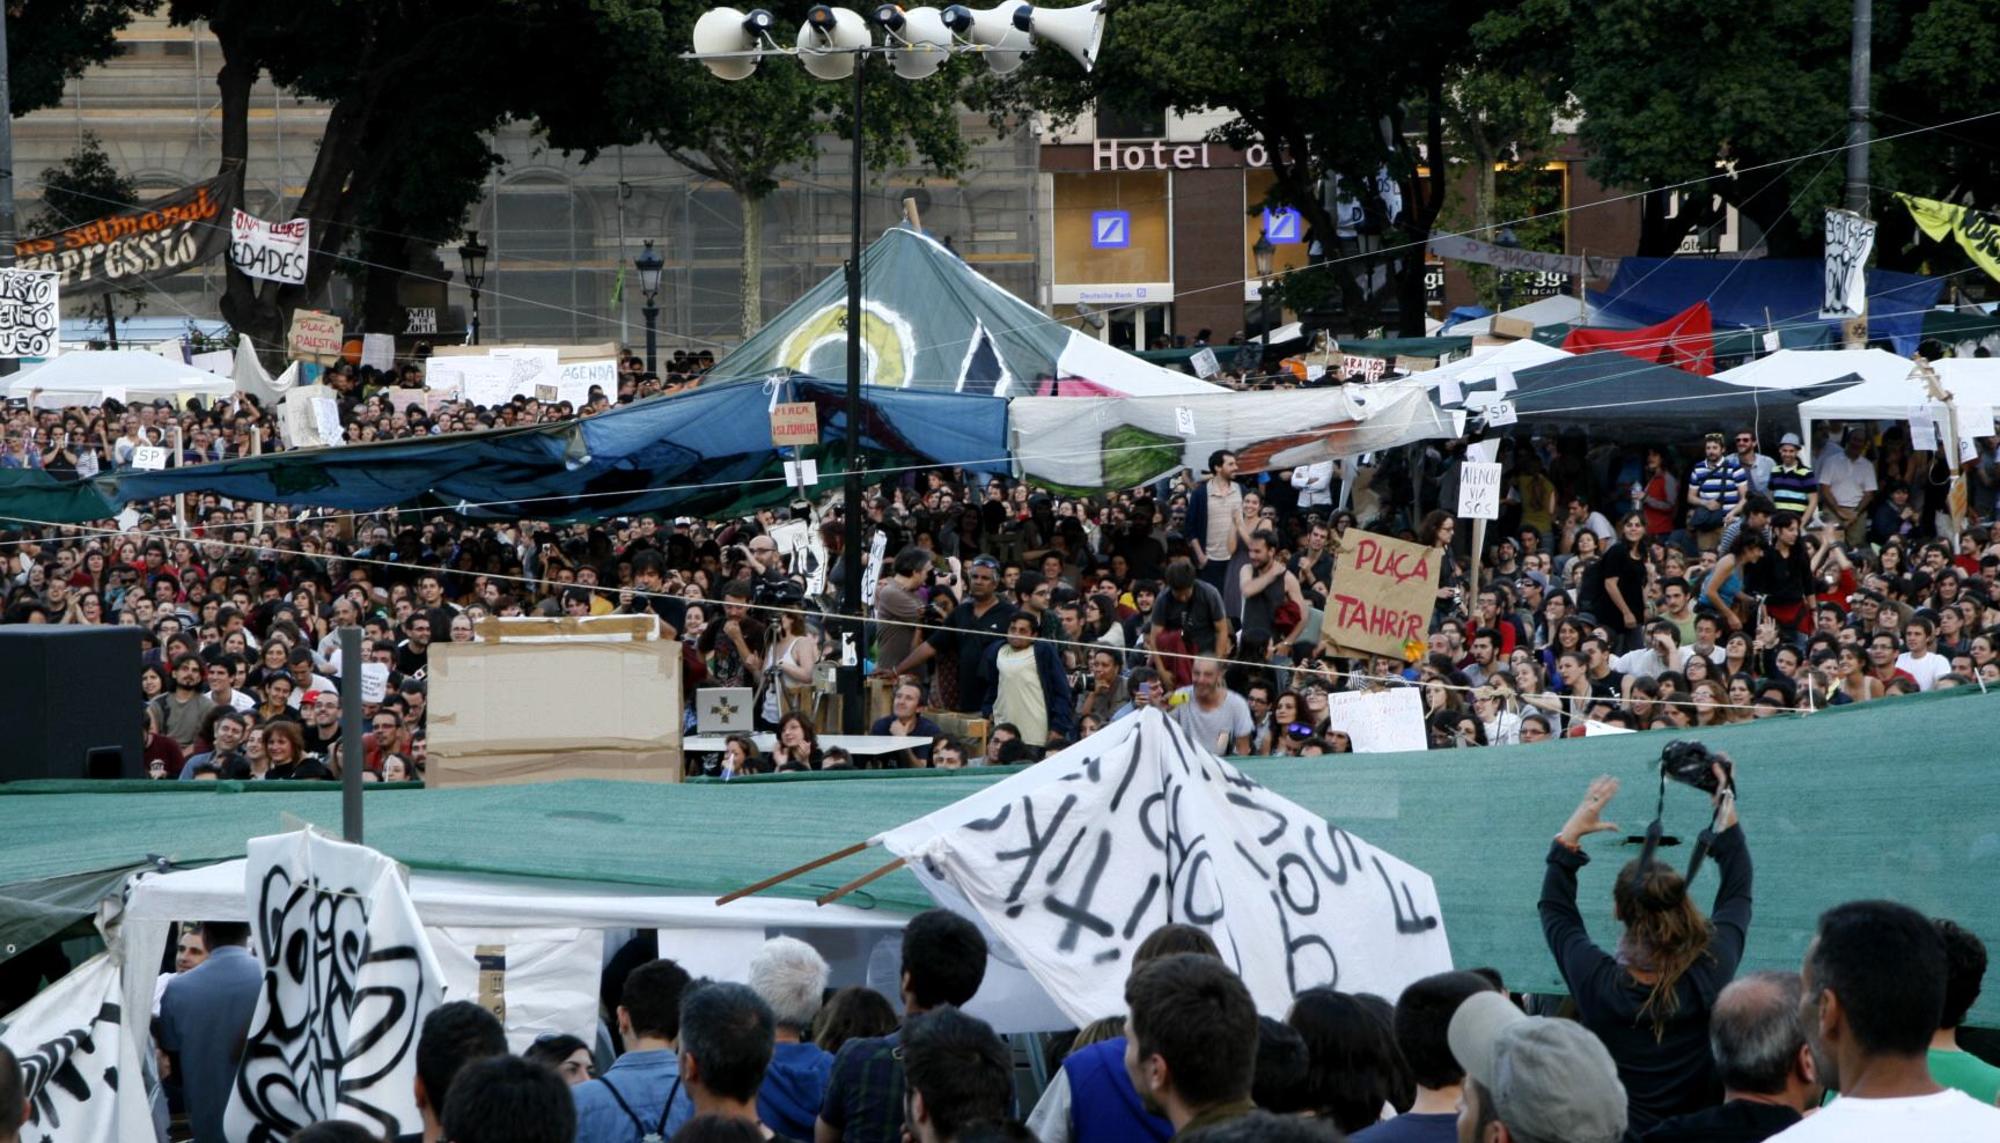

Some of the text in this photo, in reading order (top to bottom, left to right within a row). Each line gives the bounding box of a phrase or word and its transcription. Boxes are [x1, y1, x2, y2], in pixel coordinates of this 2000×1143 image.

[1093, 139, 1210, 171] Hotel
[561, 363, 616, 382] AGENDA
[138, 448, 160, 462] SP
[1464, 500, 1492, 515] SOS
[1354, 539, 1429, 585] PLAÇA
